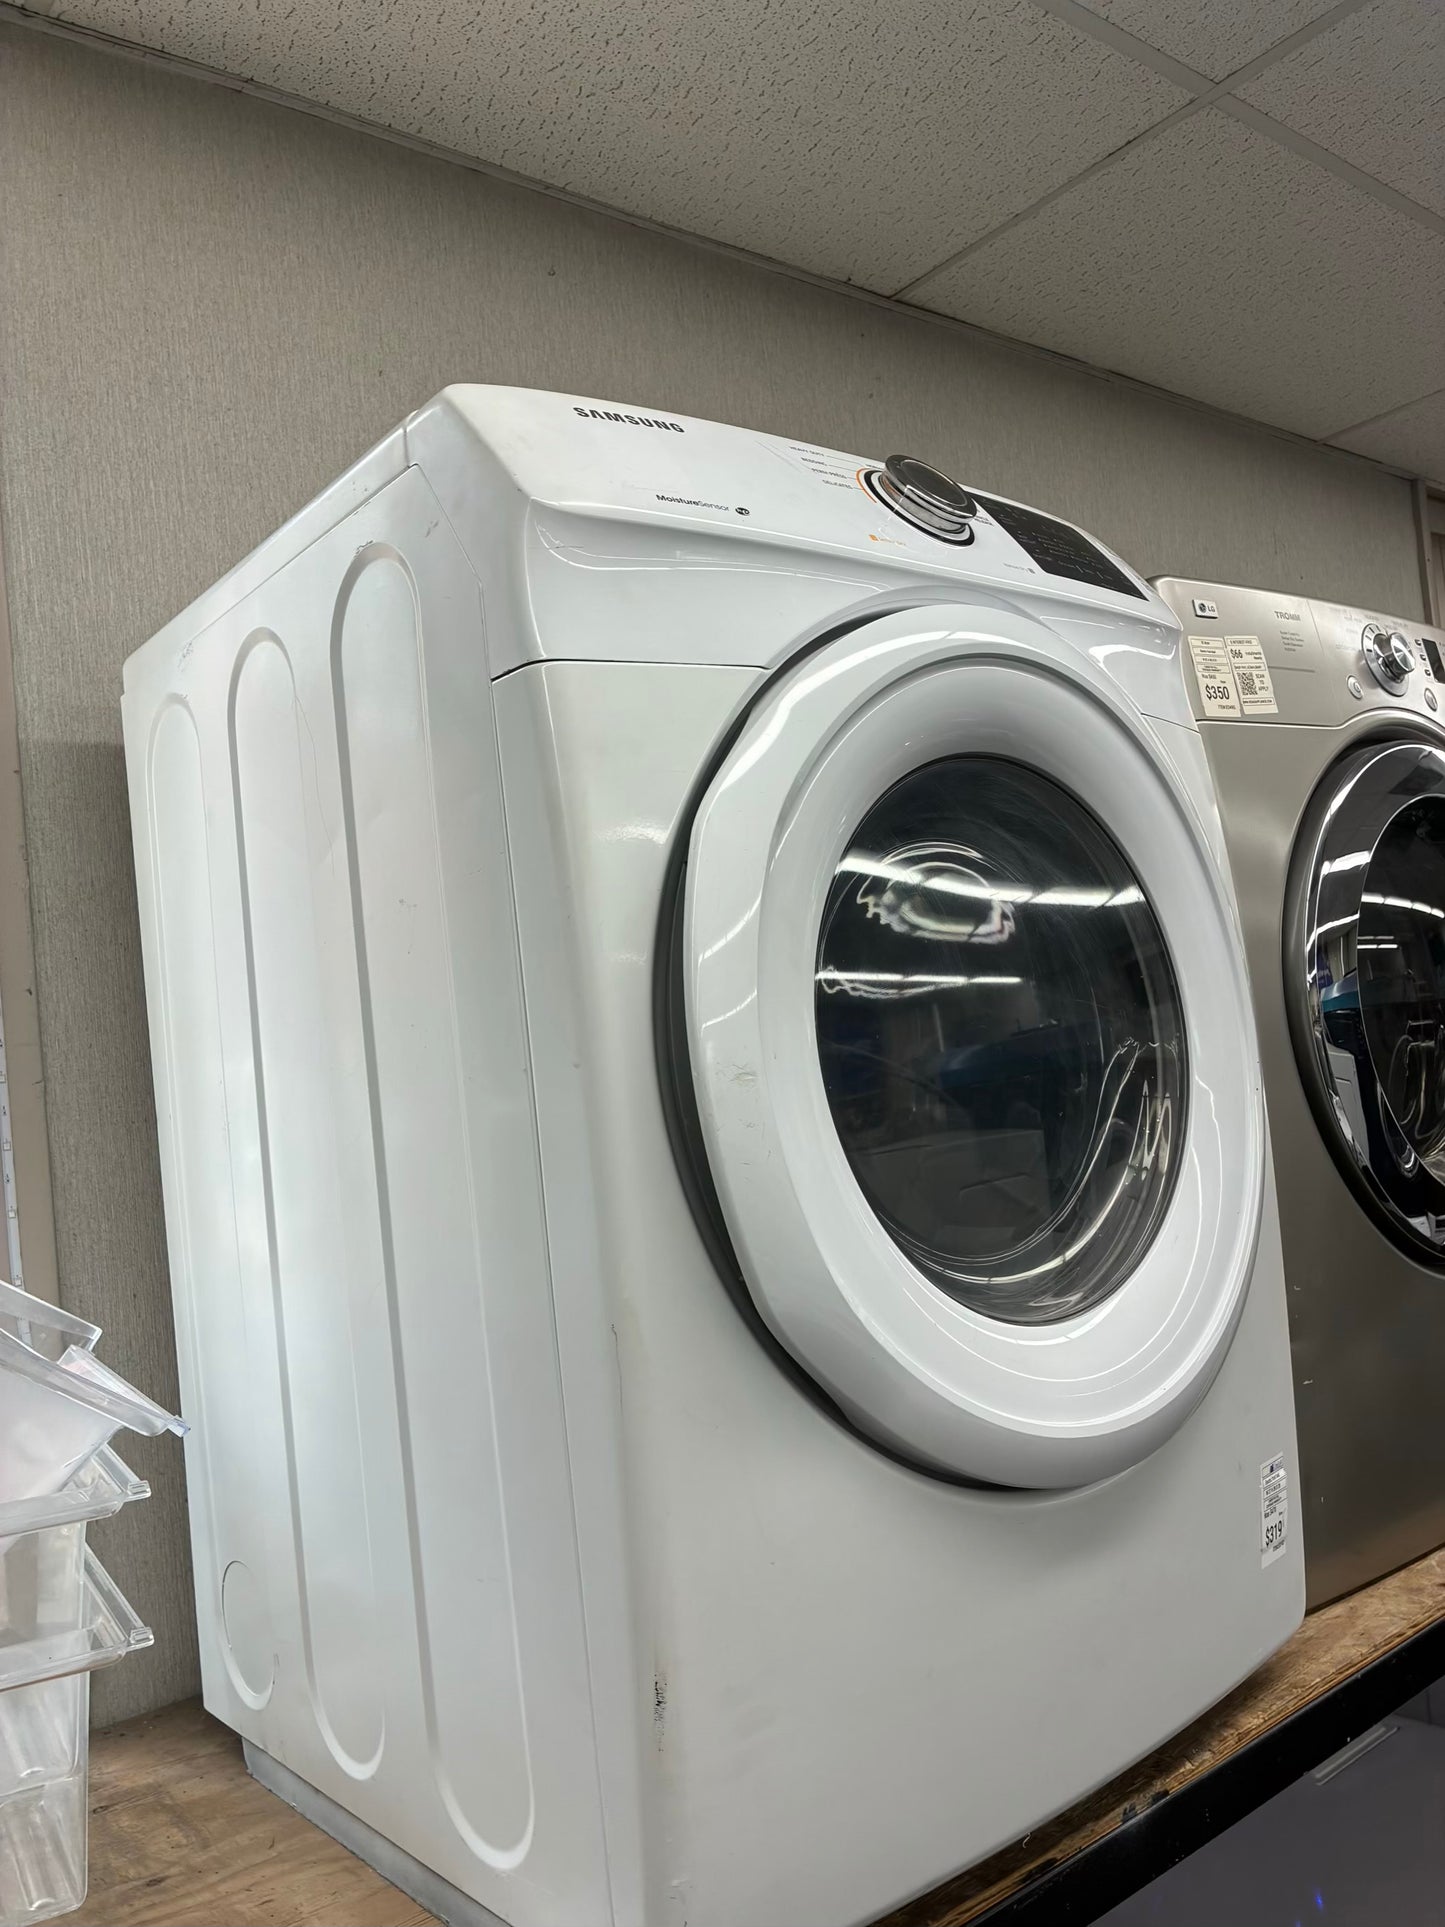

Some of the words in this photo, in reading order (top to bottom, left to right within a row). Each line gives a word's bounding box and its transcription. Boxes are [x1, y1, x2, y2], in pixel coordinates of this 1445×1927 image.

[573, 407, 685, 433] SAMSUNG
[656, 494, 729, 511] MoistureSensor
[1207, 604, 1216, 613] LG
[1205, 684, 1230, 701] $350
[1265, 1520, 1283, 1548] $319
